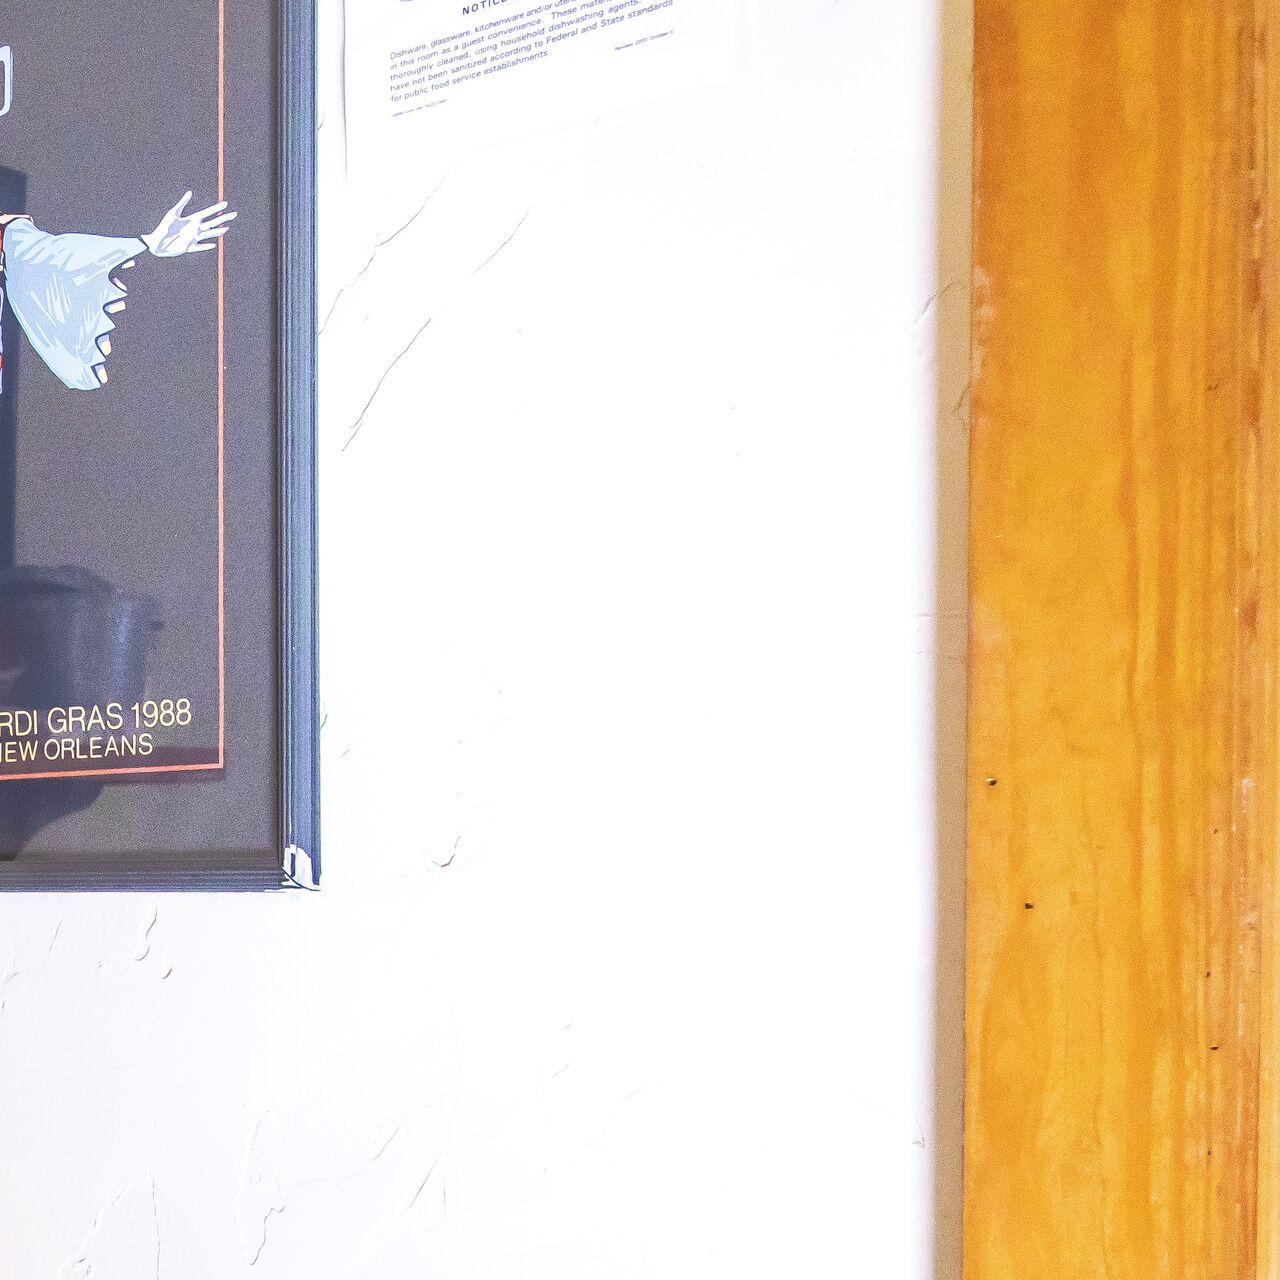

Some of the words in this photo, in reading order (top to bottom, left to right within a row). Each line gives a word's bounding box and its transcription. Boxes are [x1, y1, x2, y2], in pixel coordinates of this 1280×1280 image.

[462, 0, 507, 15] NOTIC
[390, 44, 428, 60] Dishware,
[475, 12, 524, 32] kitchenware
[390, 63, 433, 81] thoroughly
[475, 43, 497, 56] using
[501, 27, 545, 47] household
[548, 10, 604, 33] dishwashing
[390, 81, 410, 92] have
[412, 76, 425, 86] not
[428, 70, 448, 80] been
[450, 57, 487, 74] sanitized
[490, 43, 532, 62] according
[535, 39, 543, 48] to
[546, 28, 578, 44] Federal
[581, 23, 597, 34] and
[601, 15, 625, 27] State
[627, 0, 674, 19] standards
[400, 58, 415, 68] this
[417, 51, 439, 62] room
[441, 47, 451, 55] as
[462, 37, 485, 50] guest
[552, 6, 577, 19] These
[405, 86, 428, 99] public
[431, 80, 449, 91] food
[452, 71, 481, 85] service
[47, 703, 124, 734] GRAS
[131, 698, 192, 729] 1988
[44, 733, 153, 761] ORLEANS
